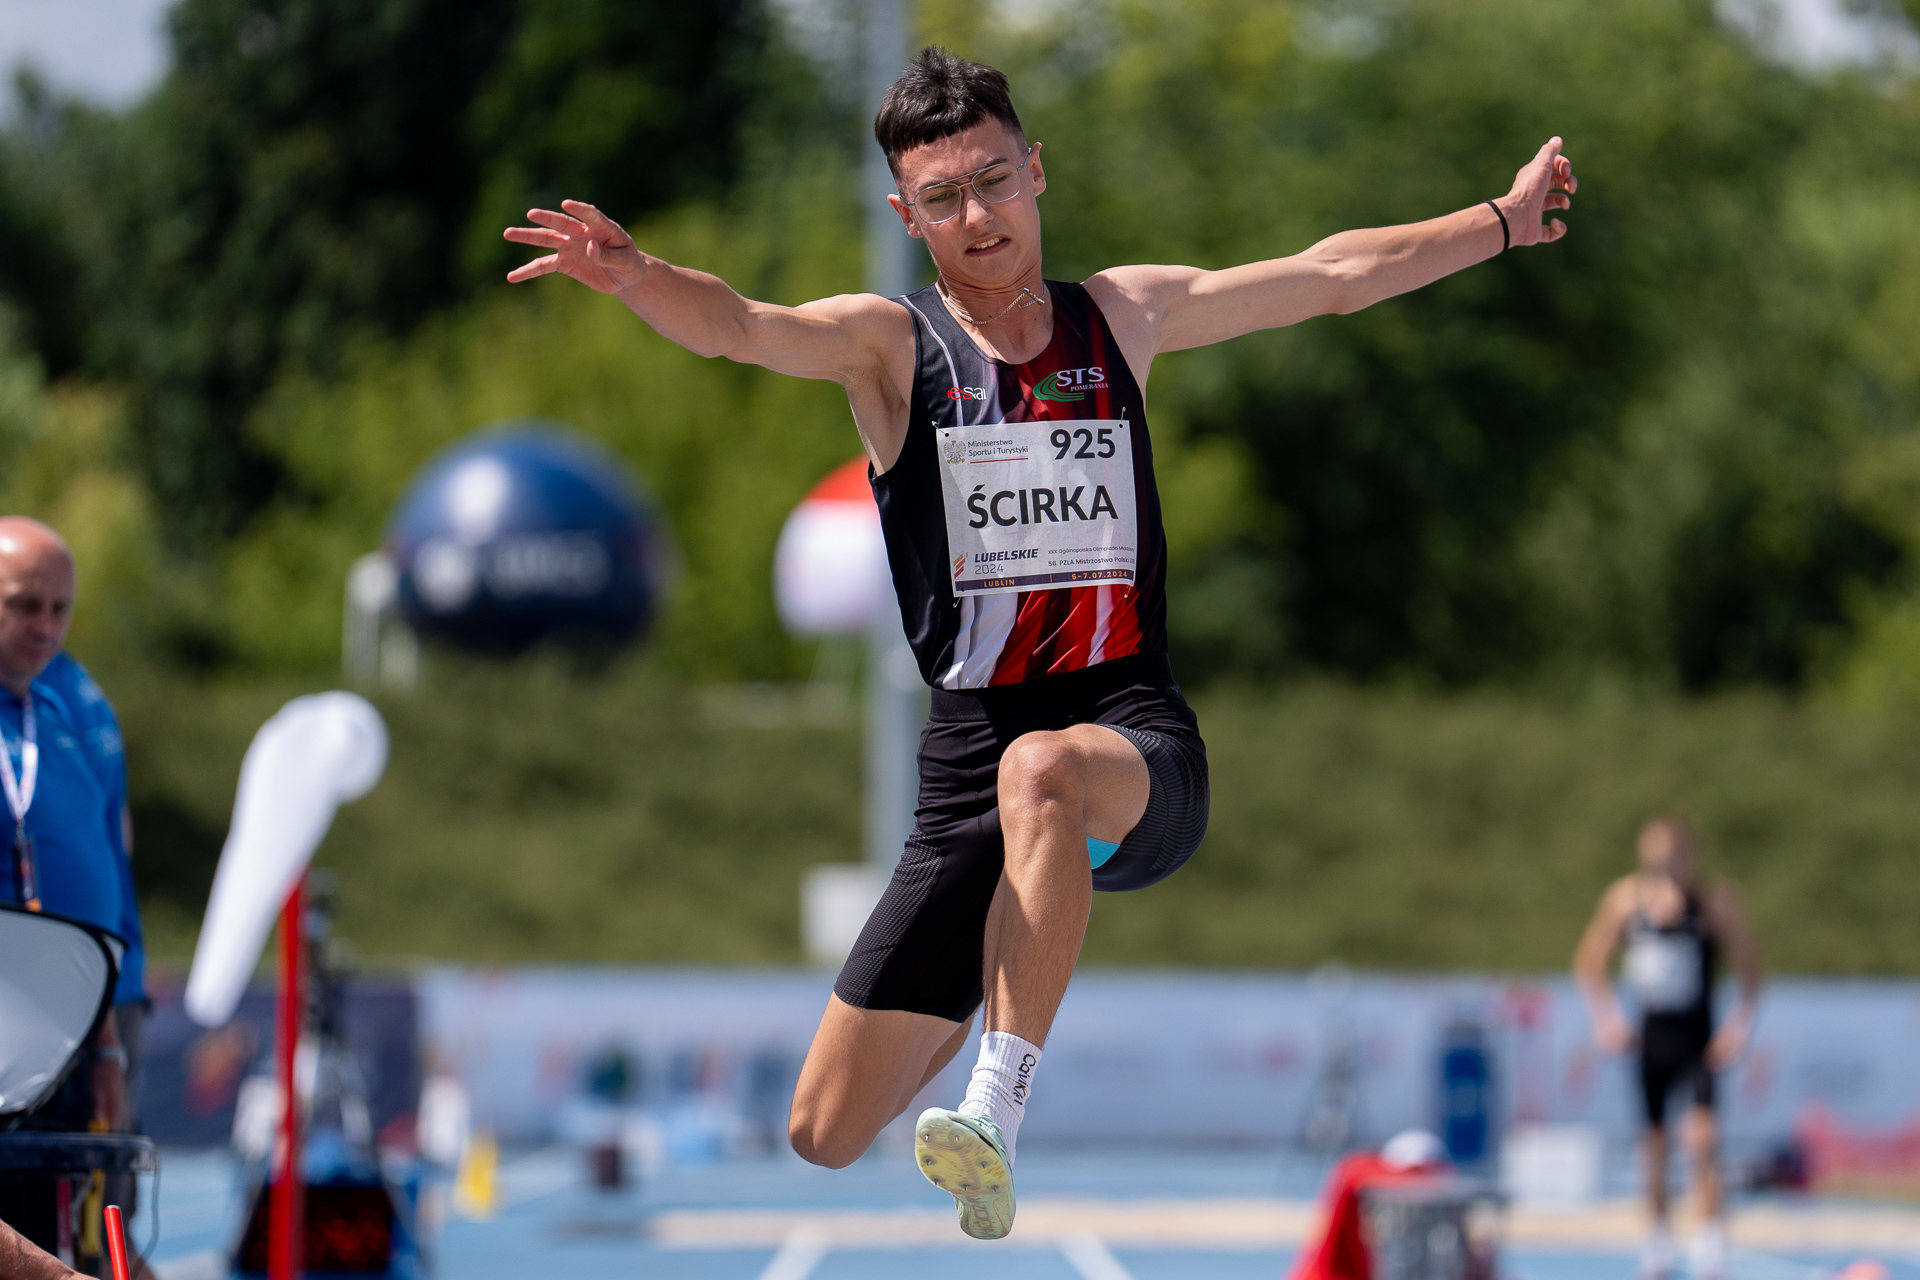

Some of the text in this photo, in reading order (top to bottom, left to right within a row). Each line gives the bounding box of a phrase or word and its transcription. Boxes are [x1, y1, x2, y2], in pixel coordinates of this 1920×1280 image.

[1056, 366, 1105, 387] STS
[1070, 382, 1109, 392] POMERANIA
[967, 439, 1013, 448] Ministerstwo
[1050, 428, 1116, 460] 925
[968, 449, 992, 457] Sportu
[997, 446, 1029, 455] Turystyki
[967, 484, 1119, 529] ŚCIRKA
[974, 548, 1039, 563] LUBELSKIE
[1075, 557, 1113, 565] Mistrzostwa
[975, 563, 1004, 575] 2024
[983, 570, 1128, 588] LUBLIN 5-7.07.2024
